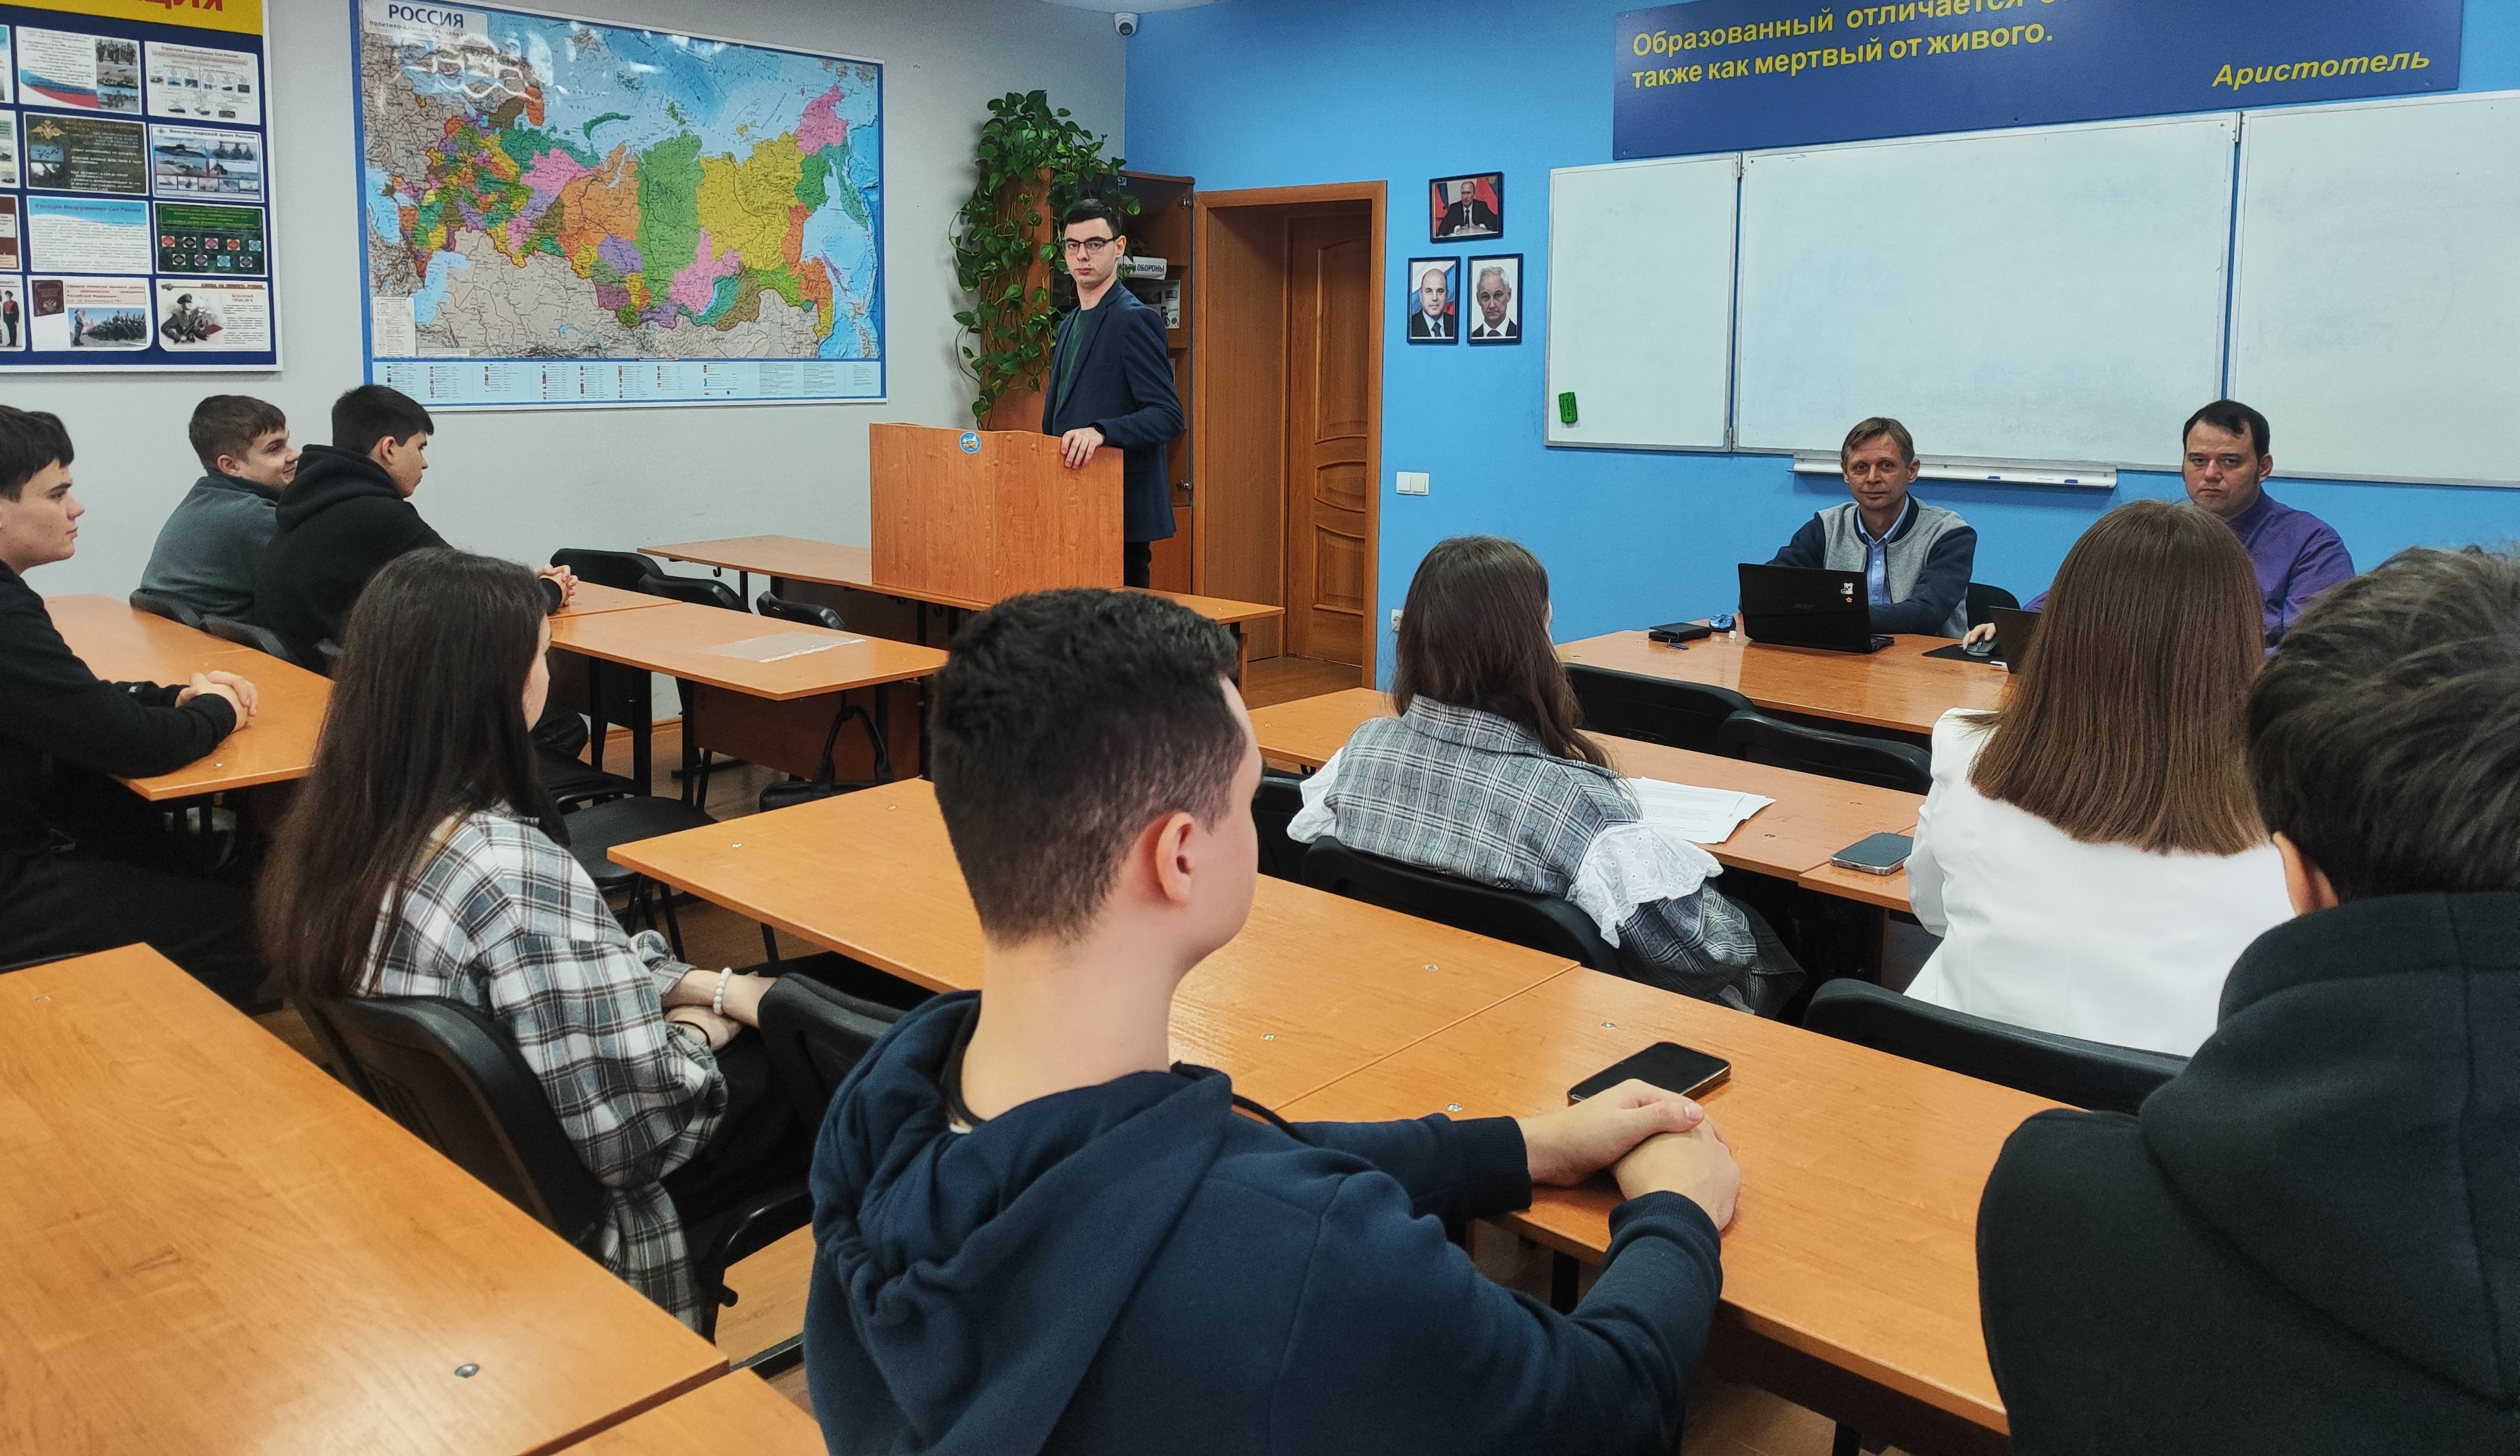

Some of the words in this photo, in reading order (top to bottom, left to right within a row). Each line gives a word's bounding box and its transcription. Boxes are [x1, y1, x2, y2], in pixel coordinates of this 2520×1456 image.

[388, 4, 464, 29] РОССИЯ
[1632, 7, 1834, 58] Образованный
[1632, 64, 1703, 89] также
[1708, 59, 1750, 81] как
[1755, 36, 1882, 77] мертвый
[1889, 37, 1923, 60] от
[1927, 23, 2053, 55] живого.
[2211, 51, 2431, 91] Аристотель
[1137, 263, 1164, 273] ОБОРОНЫ
